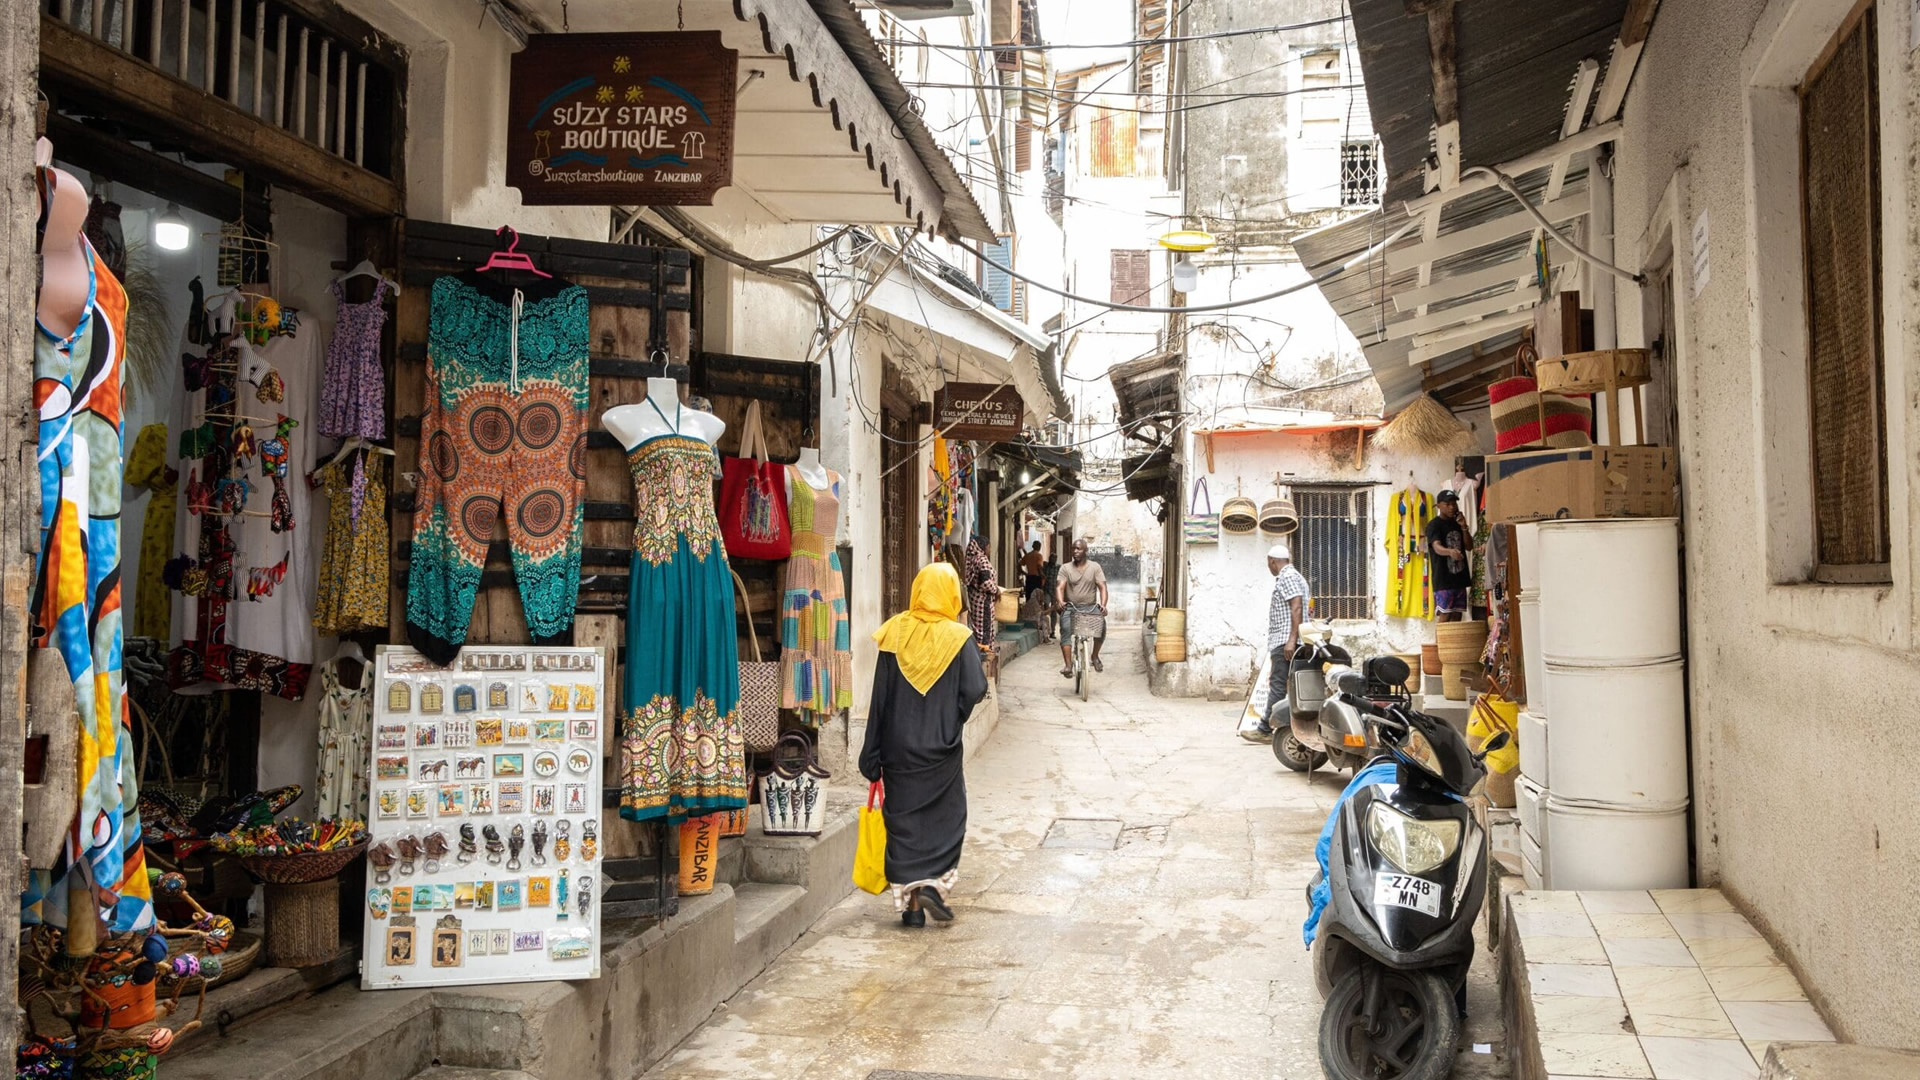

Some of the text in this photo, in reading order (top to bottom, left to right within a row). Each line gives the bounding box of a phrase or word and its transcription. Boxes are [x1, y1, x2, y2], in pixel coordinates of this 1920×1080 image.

[553, 102, 688, 128] SUZY STARS
[561, 126, 675, 154] BOUTIQUE
[544, 167, 644, 184] Suzystarsboutique
[1392, 875, 1430, 895] Z748
[1398, 890, 1418, 907] MN
